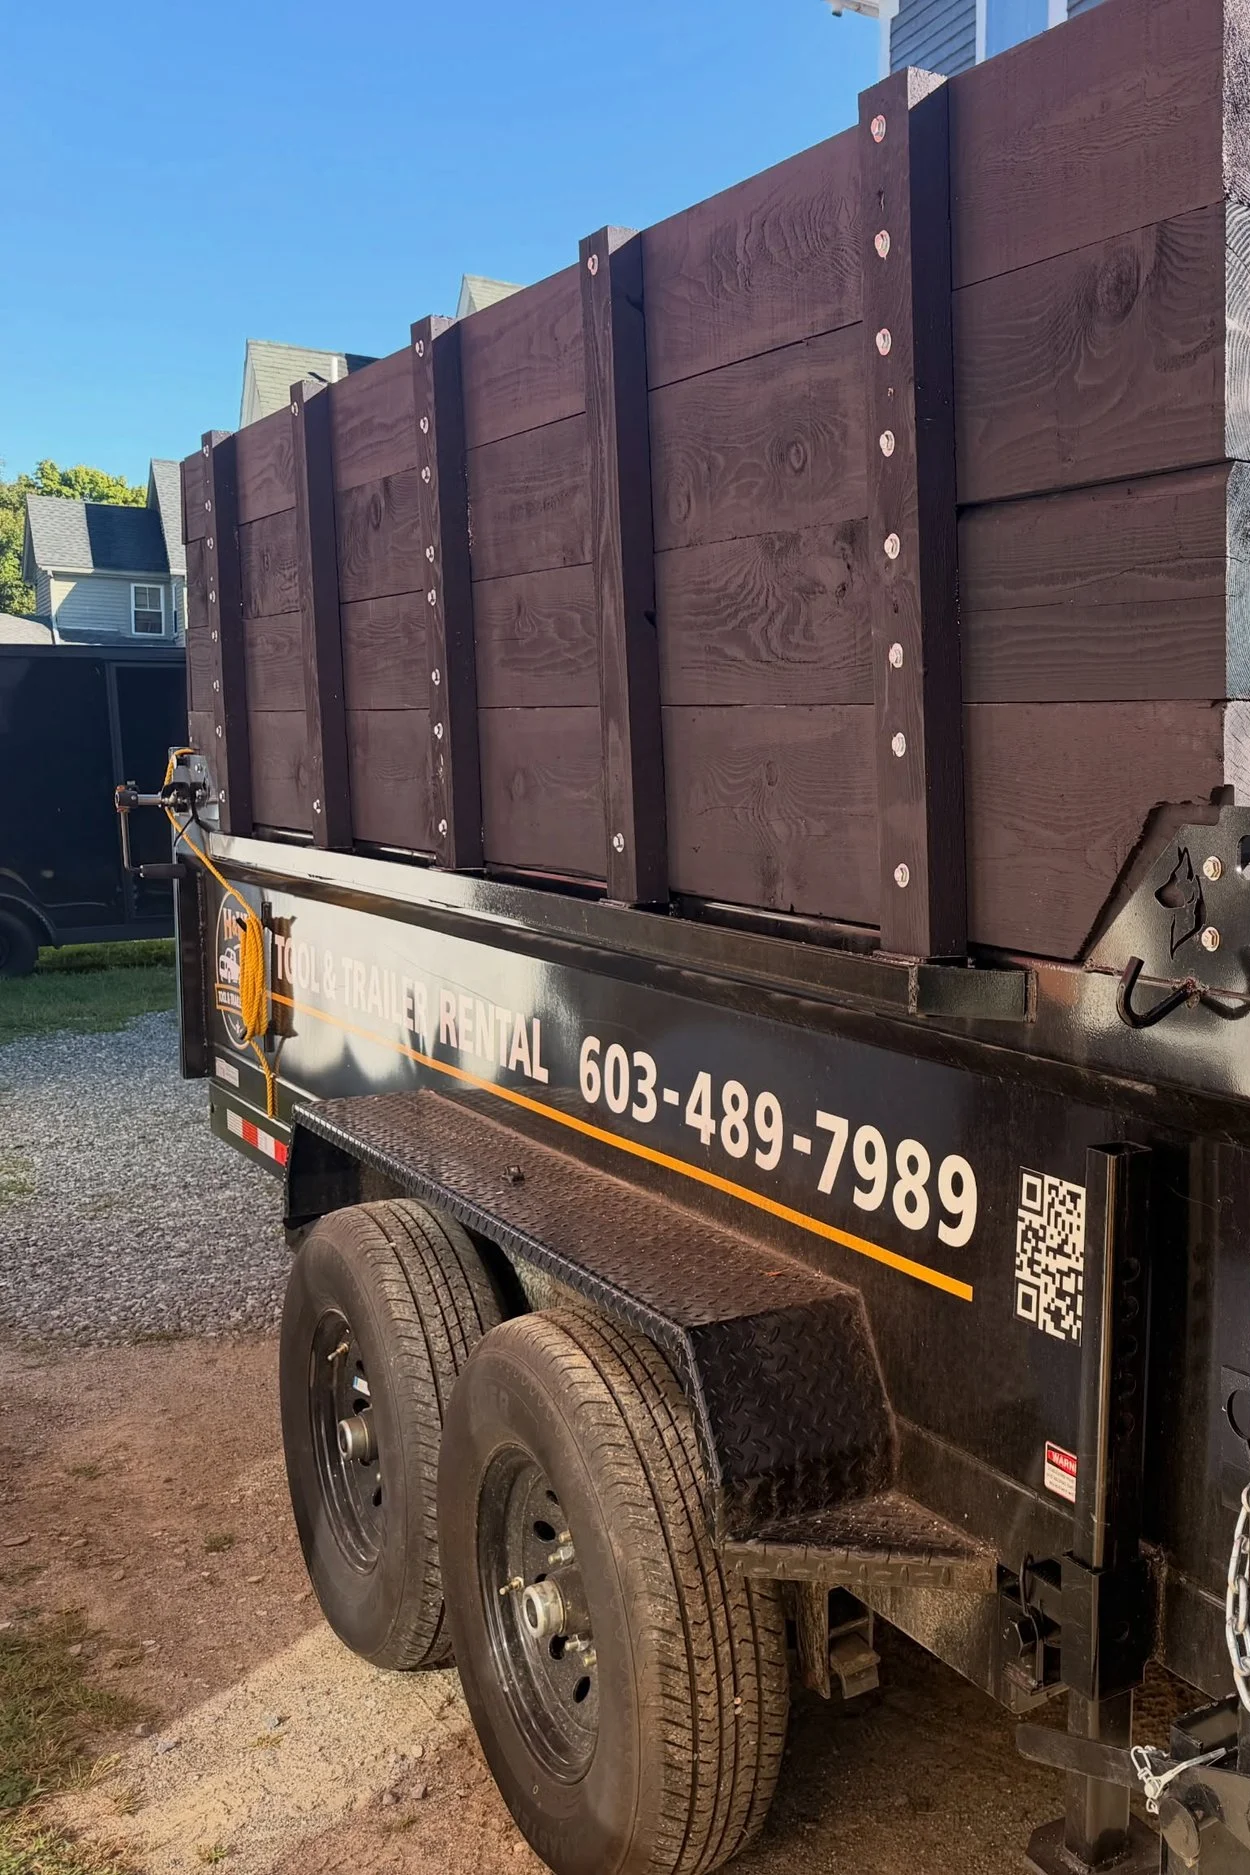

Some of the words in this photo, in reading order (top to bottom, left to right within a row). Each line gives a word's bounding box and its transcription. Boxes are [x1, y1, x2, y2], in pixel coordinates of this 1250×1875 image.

[274, 934, 320, 994] TOOL
[322, 949, 337, 1000] &
[342, 957, 429, 1038] TRAILER
[439, 988, 549, 1085] RENTAL
[579, 1035, 978, 1248] 603-489-7989
